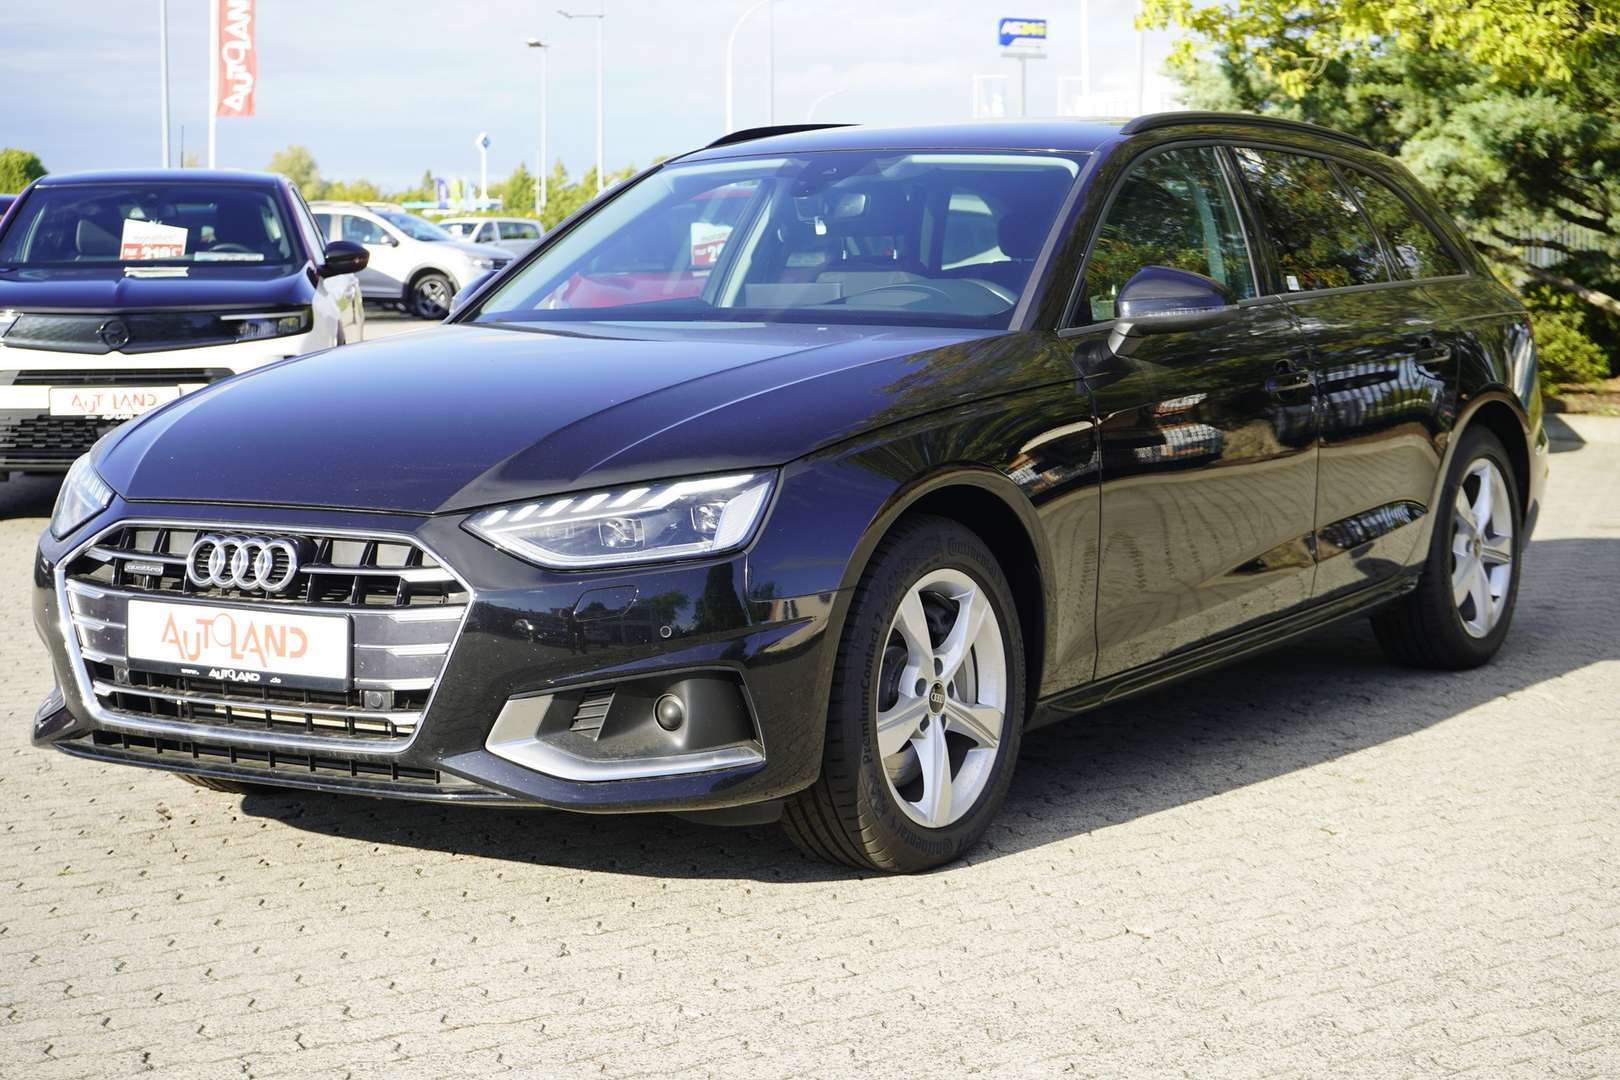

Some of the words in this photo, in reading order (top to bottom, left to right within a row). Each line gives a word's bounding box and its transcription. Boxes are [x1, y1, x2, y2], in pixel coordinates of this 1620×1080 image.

[127, 562, 161, 574] quattro
[161, 611, 308, 668] AUTOLAND
[208, 668, 261, 683] AUTOLAND
